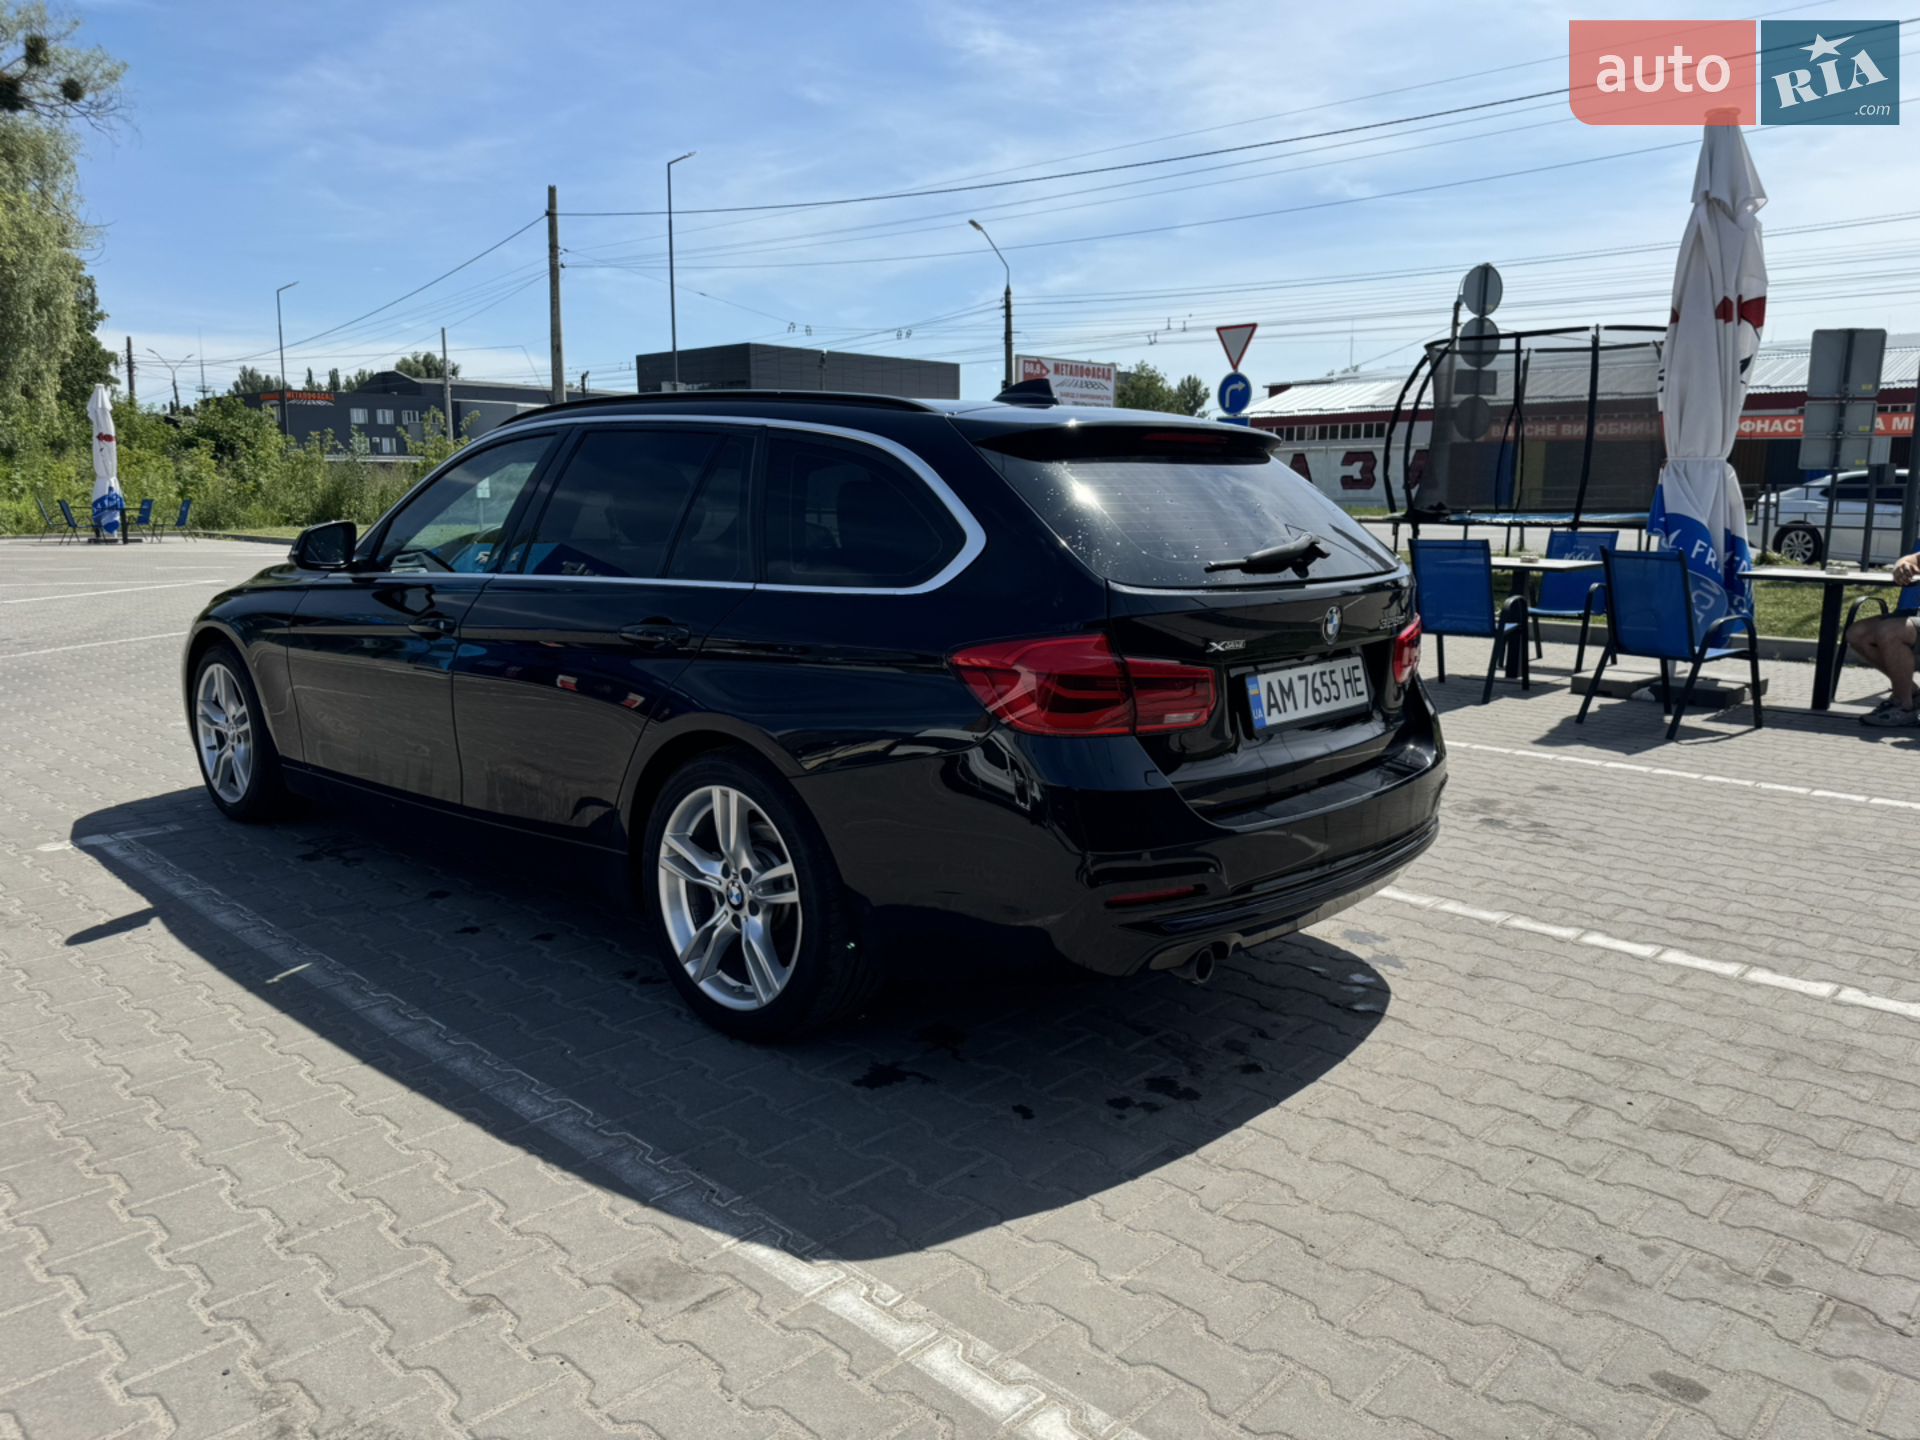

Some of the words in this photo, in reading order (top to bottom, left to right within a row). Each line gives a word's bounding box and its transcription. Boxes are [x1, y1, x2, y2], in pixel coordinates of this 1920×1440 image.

[1492, 424, 1556, 437] ВЛСНЕ
[1562, 422, 1657, 436] ВИОБНИЦ
[1266, 676, 1299, 717] AM
[1298, 670, 1341, 709] 7655
[1341, 665, 1365, 699] HE
[1253, 710, 1264, 720] UA
